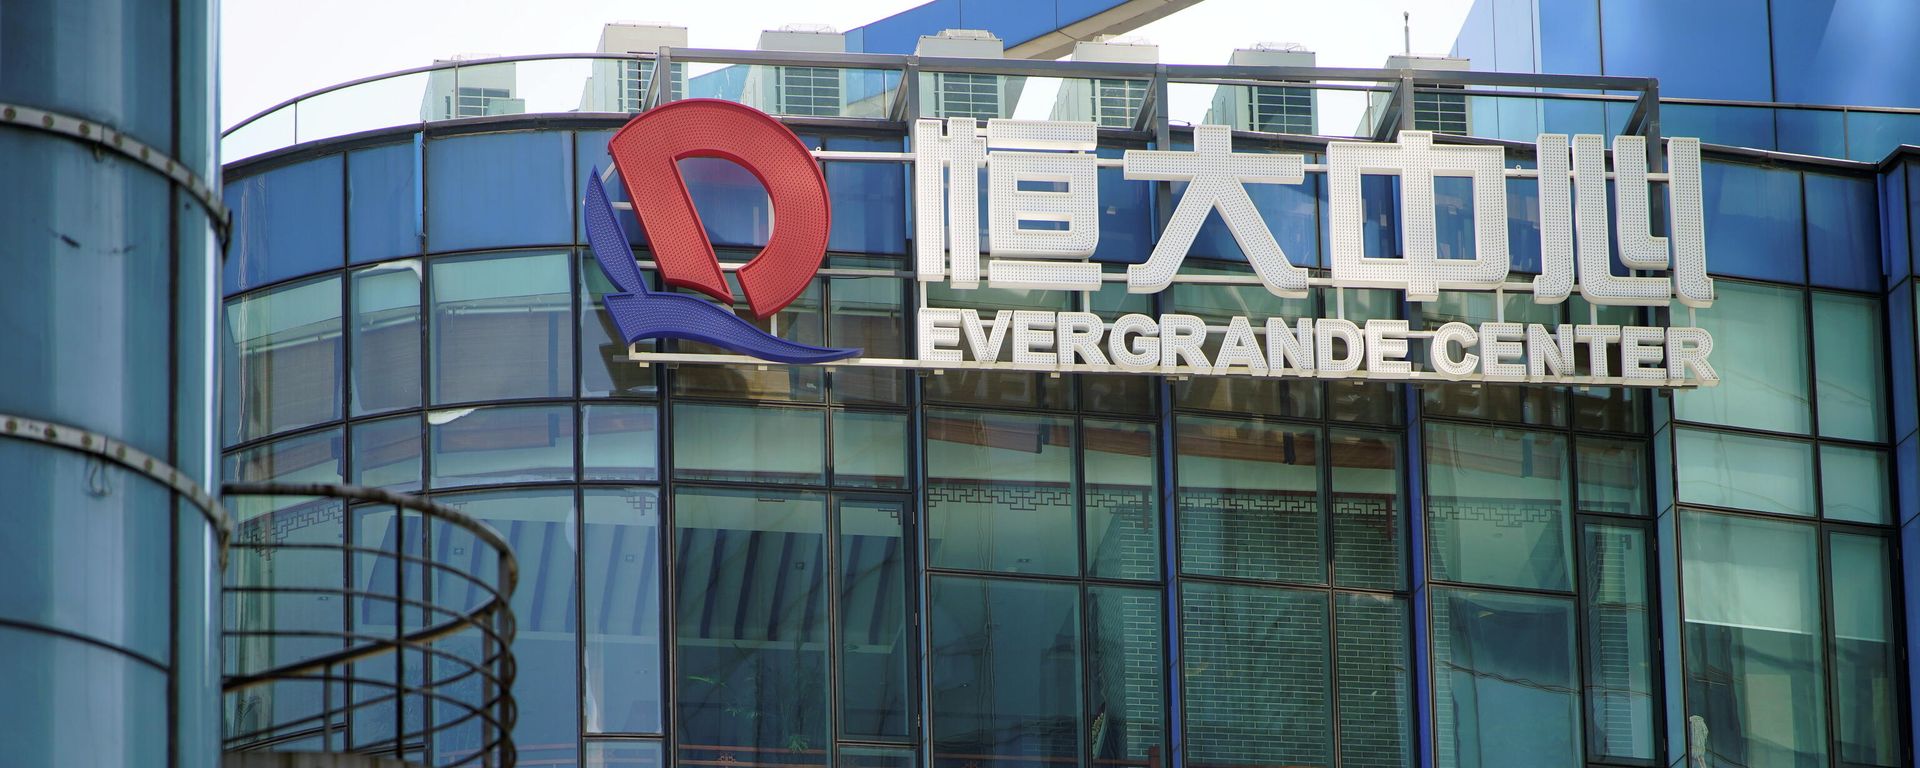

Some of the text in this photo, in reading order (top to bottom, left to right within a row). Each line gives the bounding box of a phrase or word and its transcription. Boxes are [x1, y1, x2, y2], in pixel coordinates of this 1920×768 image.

[916, 118, 1714, 308] 恒大中心
[917, 308, 1719, 387] EVERGRANDE CENTER
